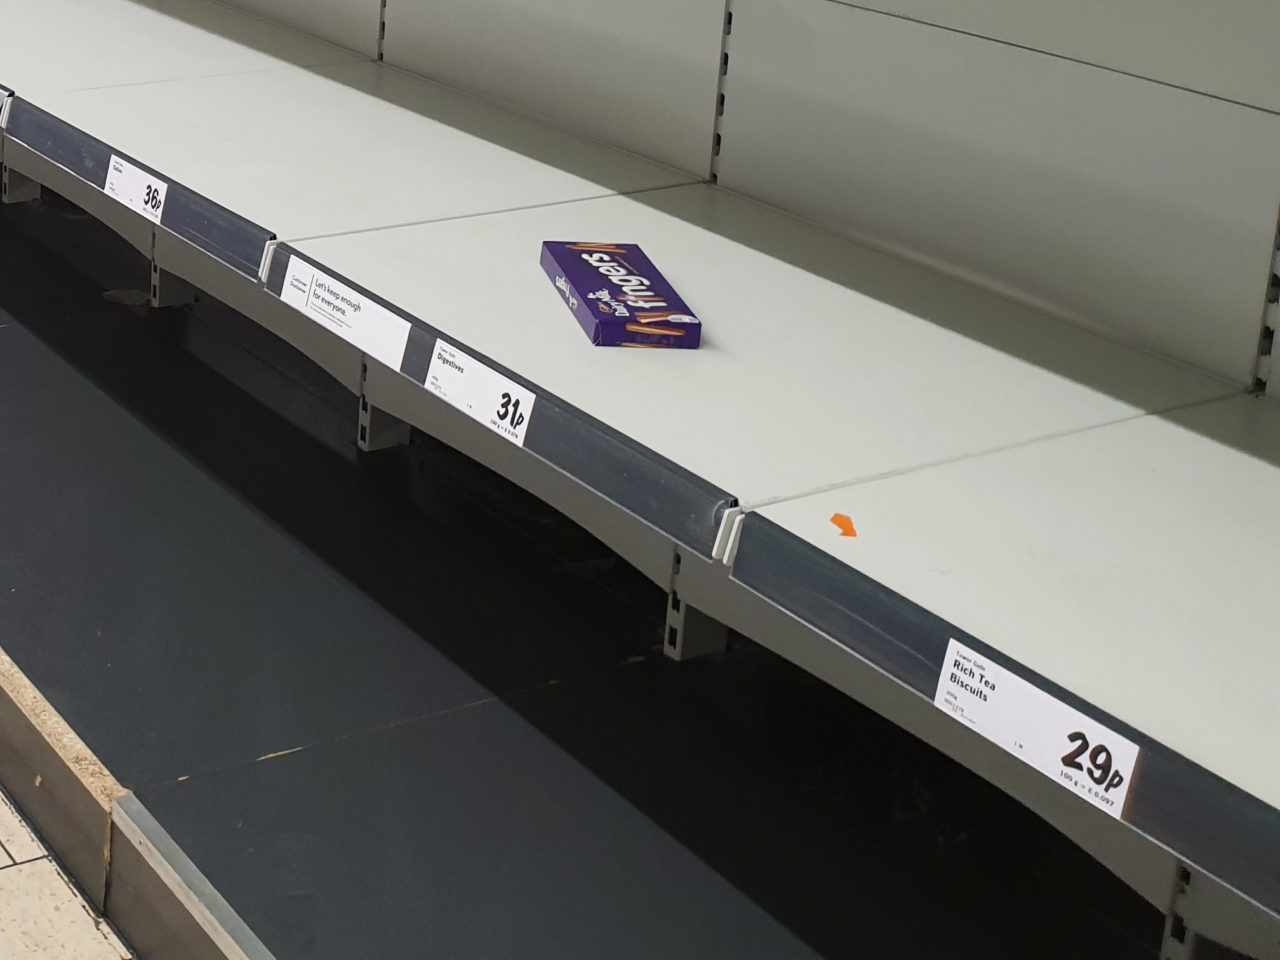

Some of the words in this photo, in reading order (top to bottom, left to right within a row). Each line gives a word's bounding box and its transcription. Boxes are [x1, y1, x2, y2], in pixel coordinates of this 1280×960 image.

[143, 184, 161, 212] 36p
[581, 252, 667, 309] fingers
[327, 285, 340, 300] keep
[341, 296, 362, 312] enough
[437, 353, 464, 374] Digestives
[496, 392, 524, 429] 31p
[949, 672, 988, 702] Biscuits
[953, 659, 975, 679] Rich
[979, 673, 996, 691] Tea
[1060, 770, 1073, 782] 100
[1061, 731, 1124, 793] 29p
